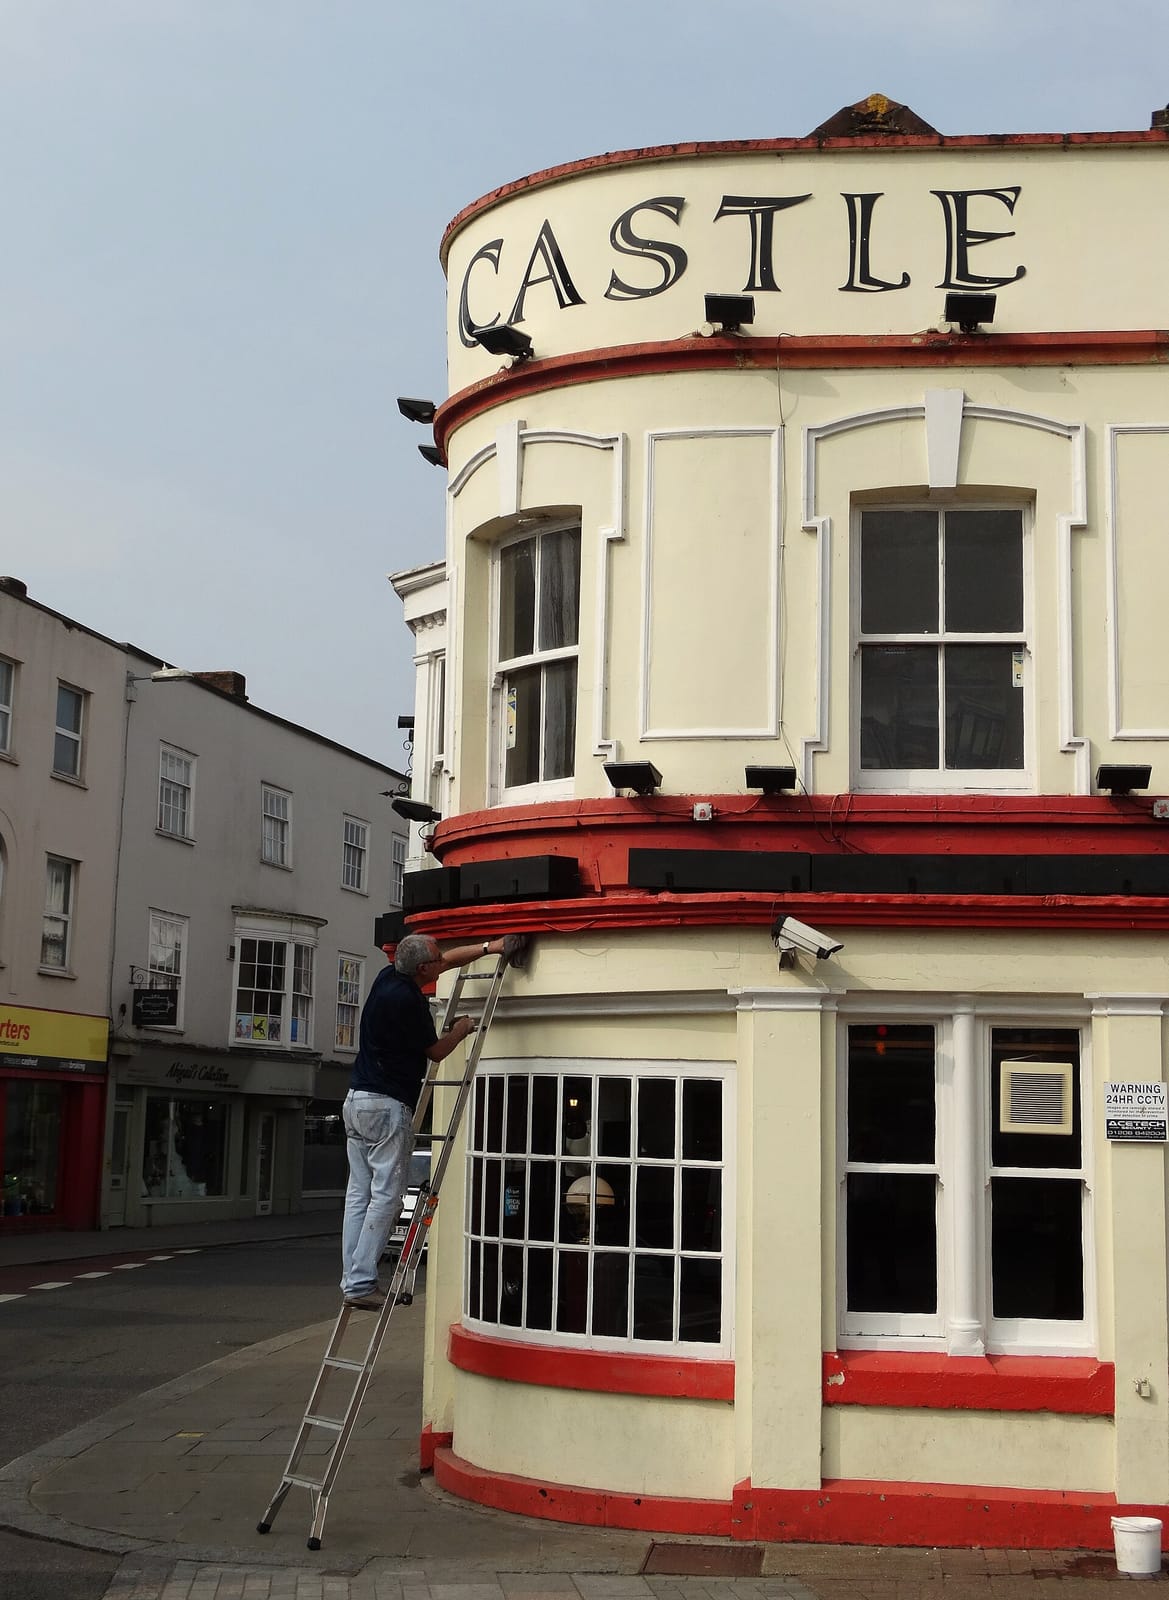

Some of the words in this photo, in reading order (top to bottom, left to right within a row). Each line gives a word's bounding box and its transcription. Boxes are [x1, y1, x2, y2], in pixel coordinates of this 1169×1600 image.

[458, 186, 1026, 349] CASTLE
[1110, 1084, 1161, 1094] WARNING
[1106, 1095, 1133, 1104] 24HR
[1137, 1095, 1165, 1104] CCTV
